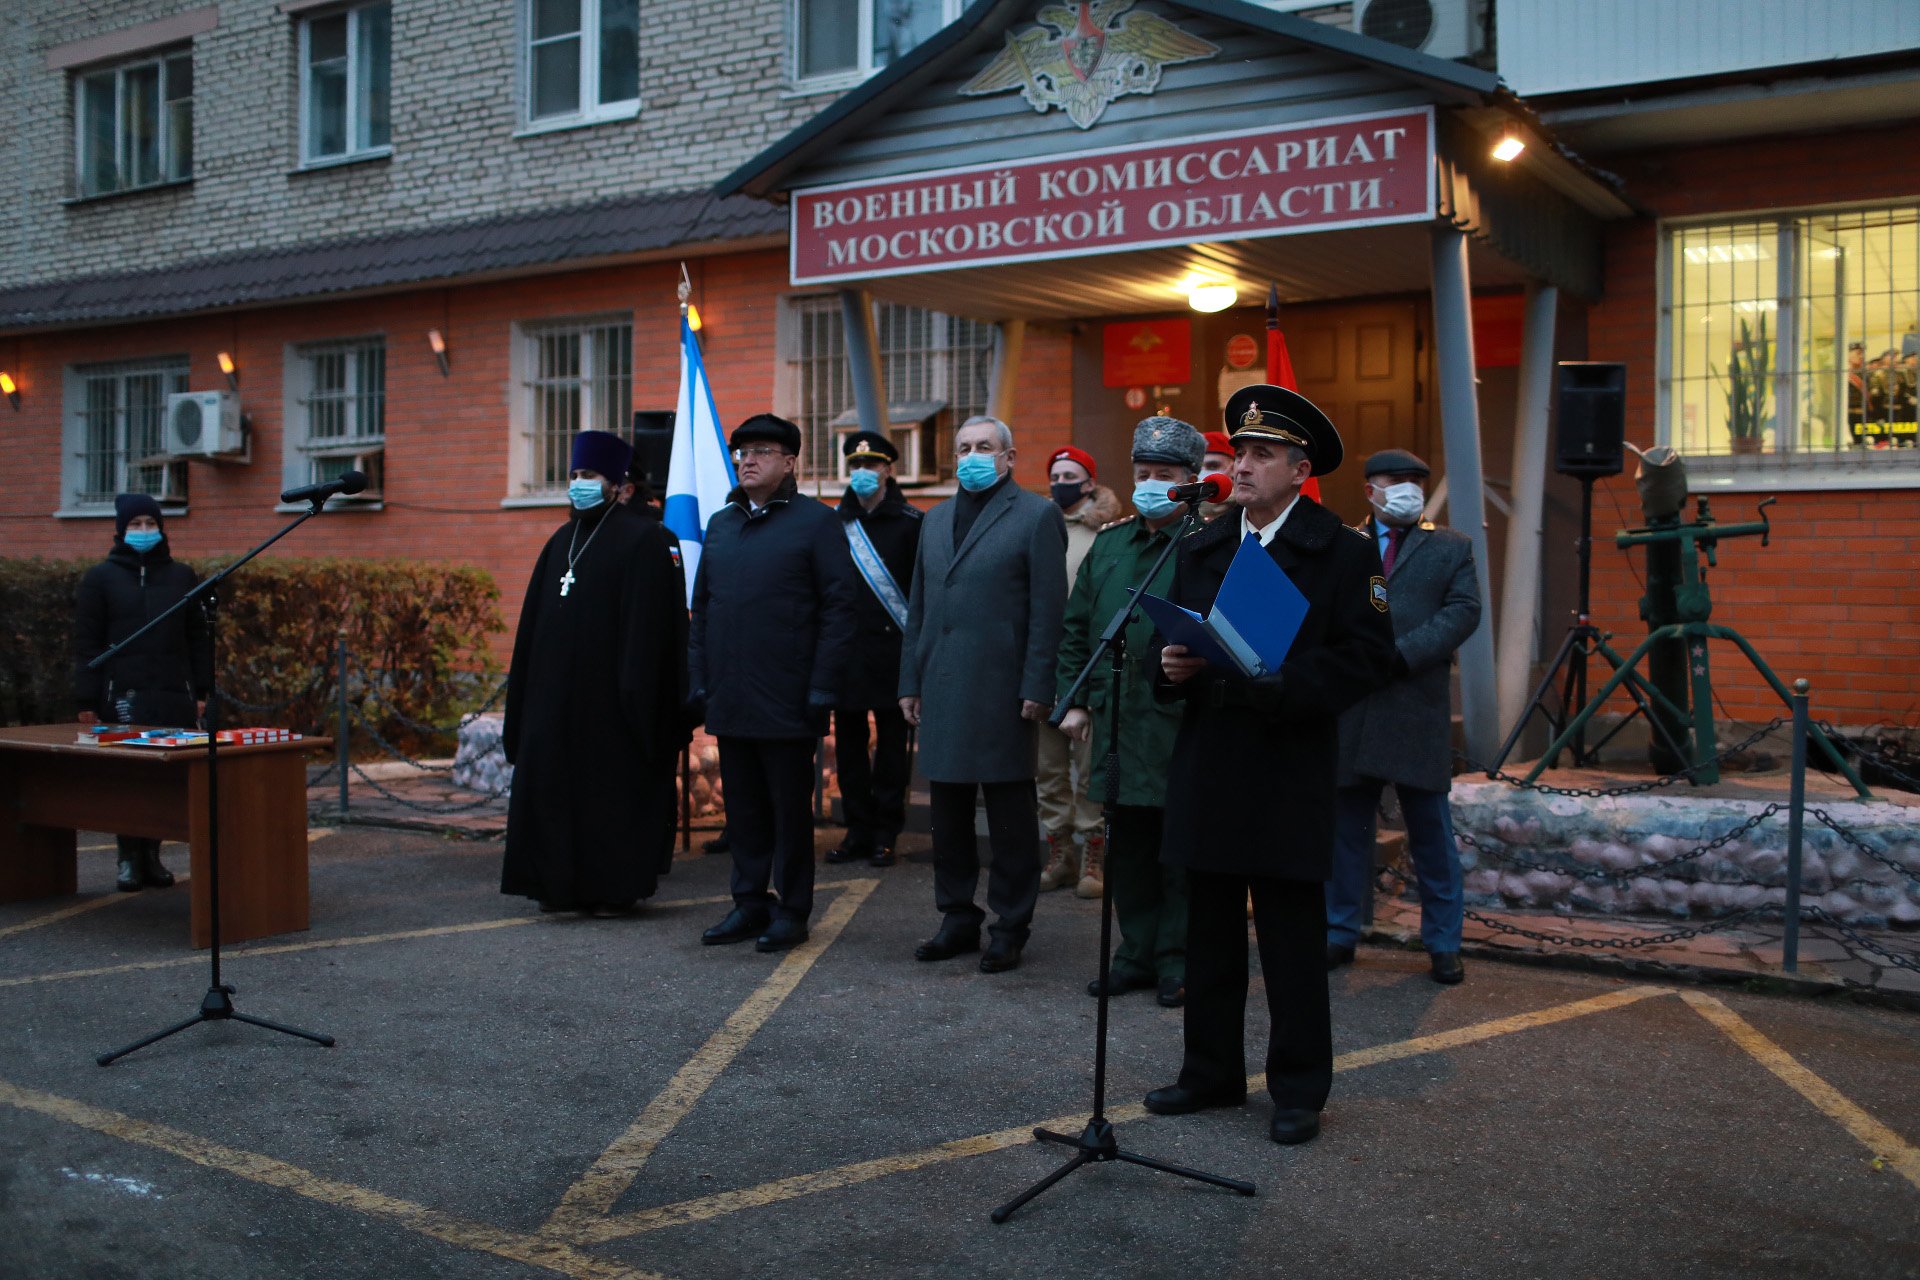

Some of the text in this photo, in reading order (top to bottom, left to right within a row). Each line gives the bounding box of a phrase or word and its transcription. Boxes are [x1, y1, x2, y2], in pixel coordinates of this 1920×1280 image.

[812, 128, 1406, 229] ВОЕННЫЙ КОМИССАРИАТ
[826, 178, 1383, 267] МОСКОВСКОЙ ОБЛАСТИ
